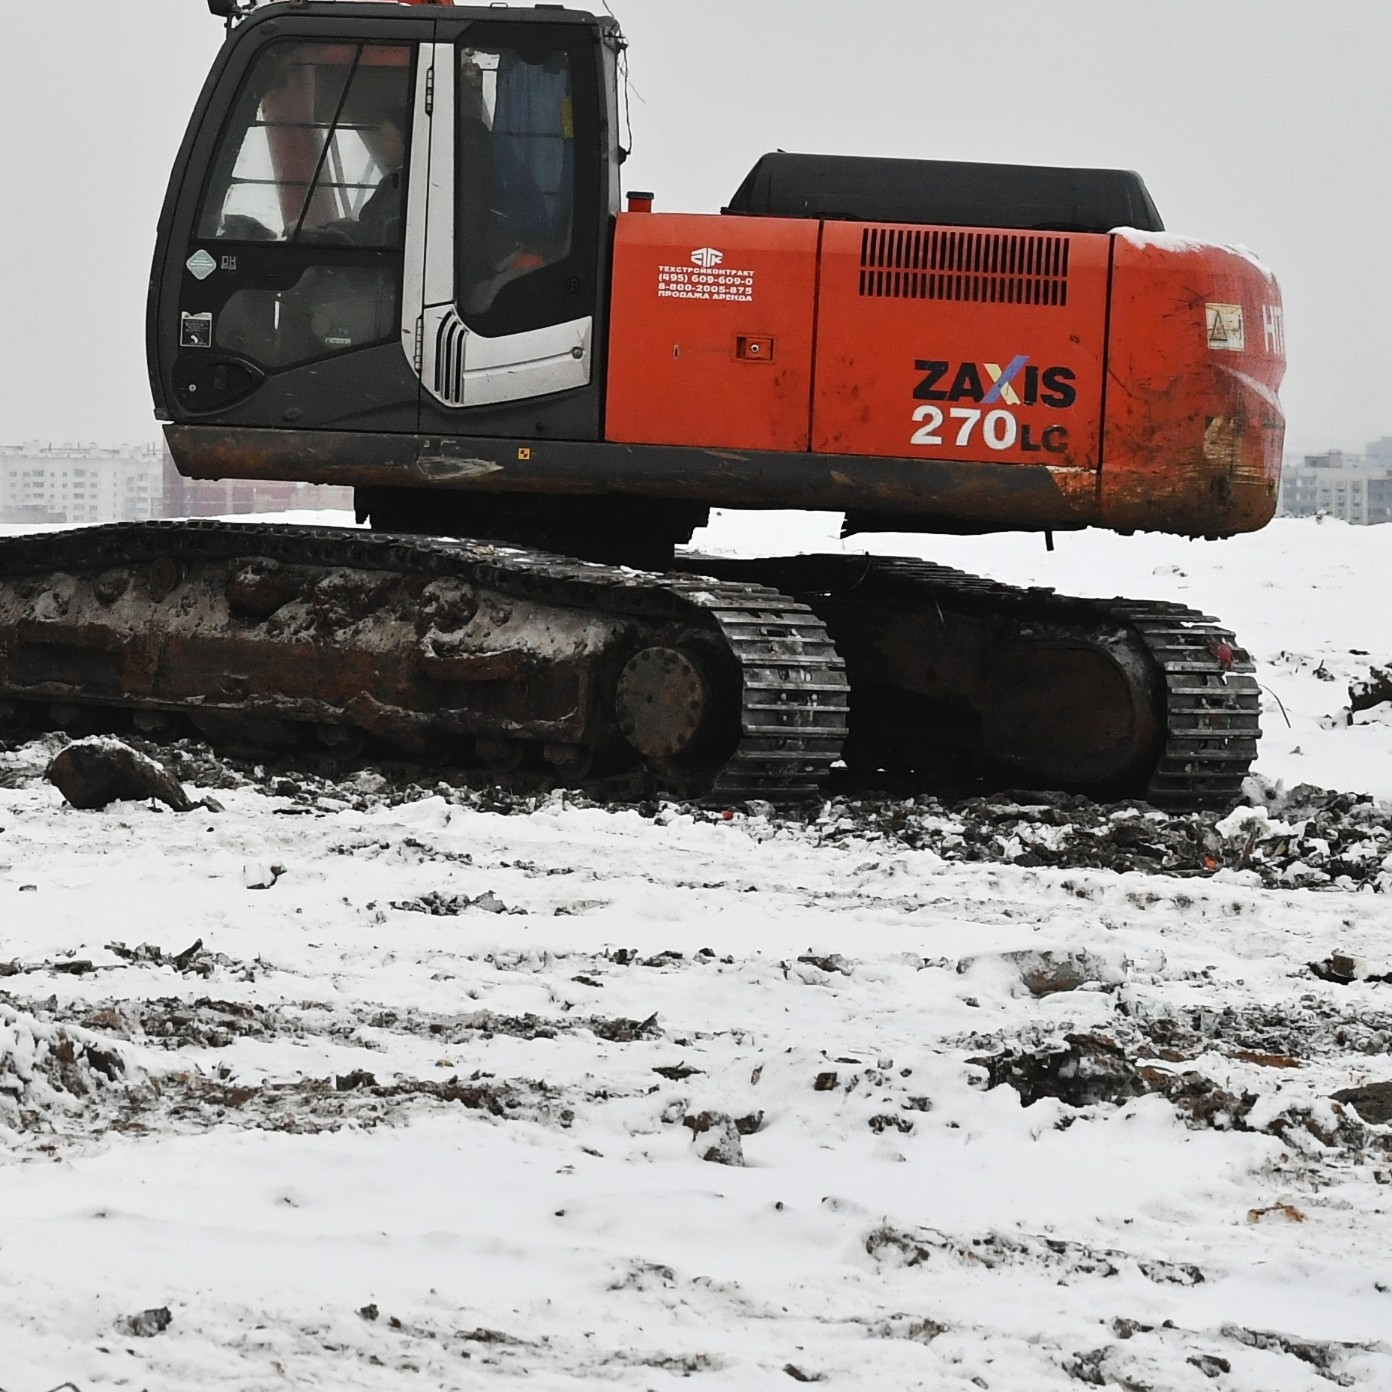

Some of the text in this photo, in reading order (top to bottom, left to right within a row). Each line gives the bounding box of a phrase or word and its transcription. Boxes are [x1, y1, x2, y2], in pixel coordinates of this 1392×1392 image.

[658, 265, 755, 277] ТЕХСТРОЙКОНТРАКТ
[658, 273, 753, 286] (495) 609-609-0
[658, 282, 753, 295] 8-800-2005-875
[658, 290, 753, 302] ПРОДАЖА АРЕНДА
[912, 355, 1077, 409] ZAXIS
